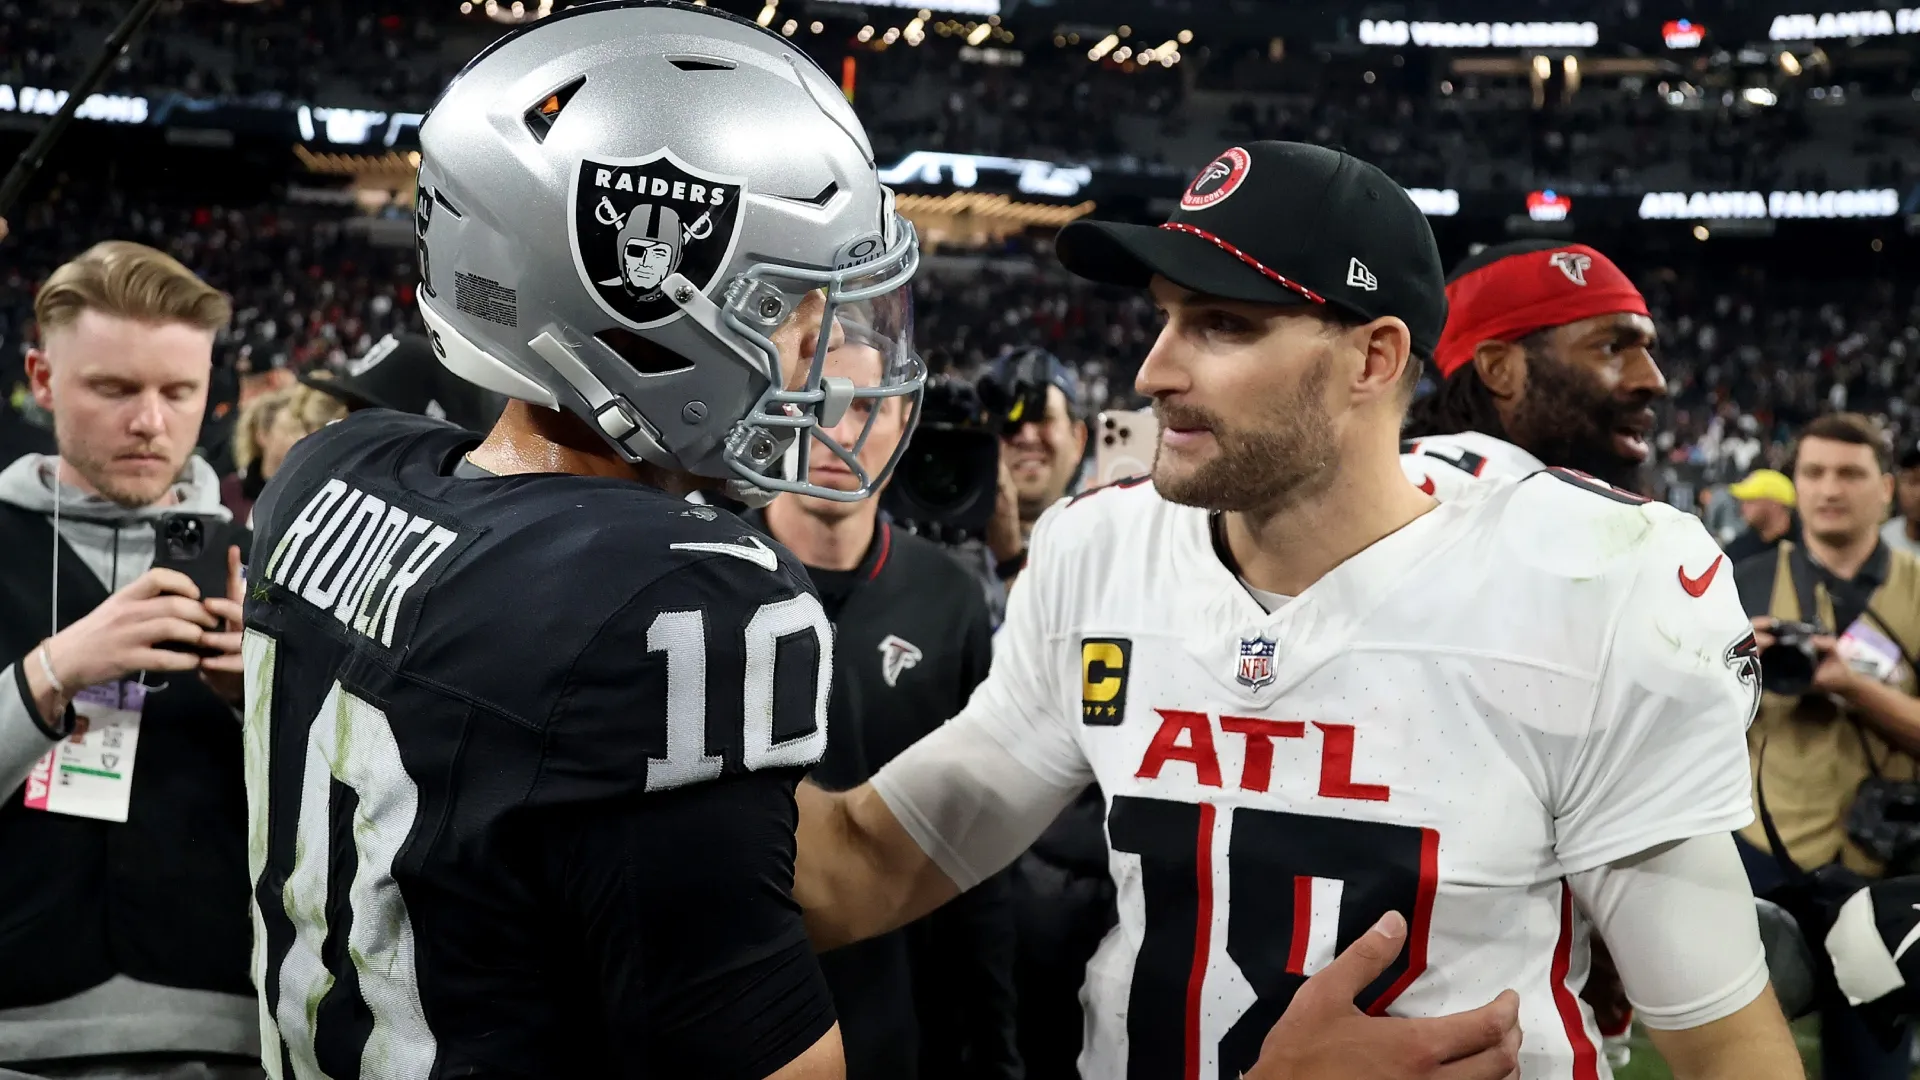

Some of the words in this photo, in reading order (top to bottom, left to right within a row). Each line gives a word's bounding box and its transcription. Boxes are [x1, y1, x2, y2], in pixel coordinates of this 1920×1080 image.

[595, 168, 725, 205] RAIDERS
[467, 272, 499, 286] WARNING
[264, 478, 459, 648] RIDDER
[645, 591, 834, 792] 10
[1083, 643, 1124, 703] C
[1240, 658, 1269, 680] NFL
[1134, 708, 1390, 802] ATL
